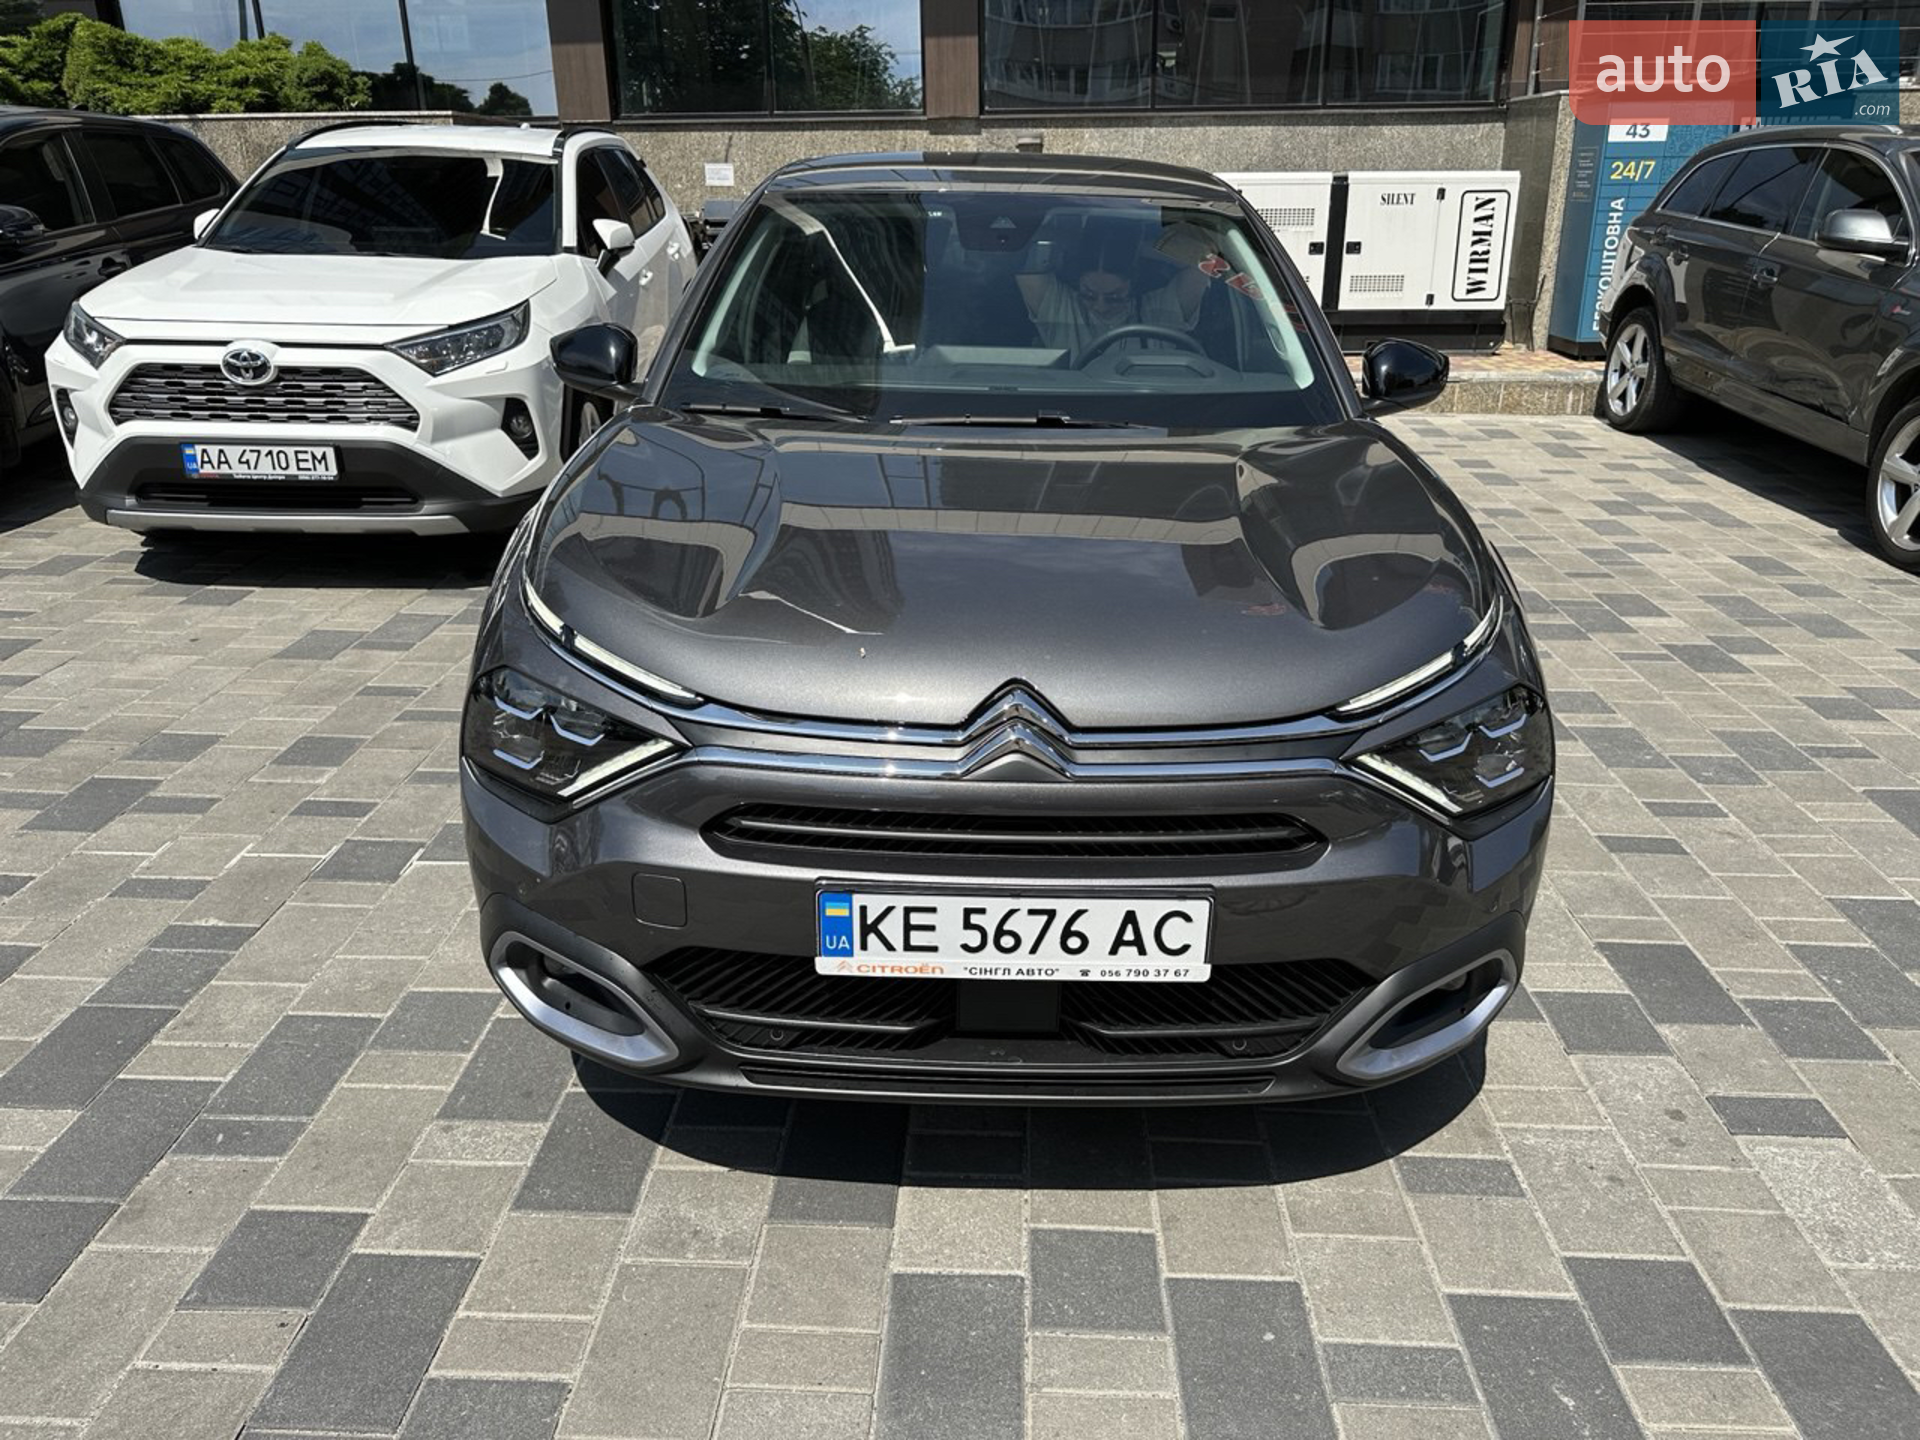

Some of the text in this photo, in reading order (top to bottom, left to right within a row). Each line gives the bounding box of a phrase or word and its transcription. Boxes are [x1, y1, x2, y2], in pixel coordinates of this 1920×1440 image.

[1625, 122, 1651, 139] 43
[1610, 160, 1656, 182] 24/7
[1380, 192, 1416, 206] SILENT
[1466, 196, 1497, 296] WIRMAN
[200, 448, 330, 472] AA 4710 EM
[859, 905, 1194, 956] KE 5676 AC
[825, 935, 850, 949] UA
[1100, 968, 1190, 977] 056 790 37 67
